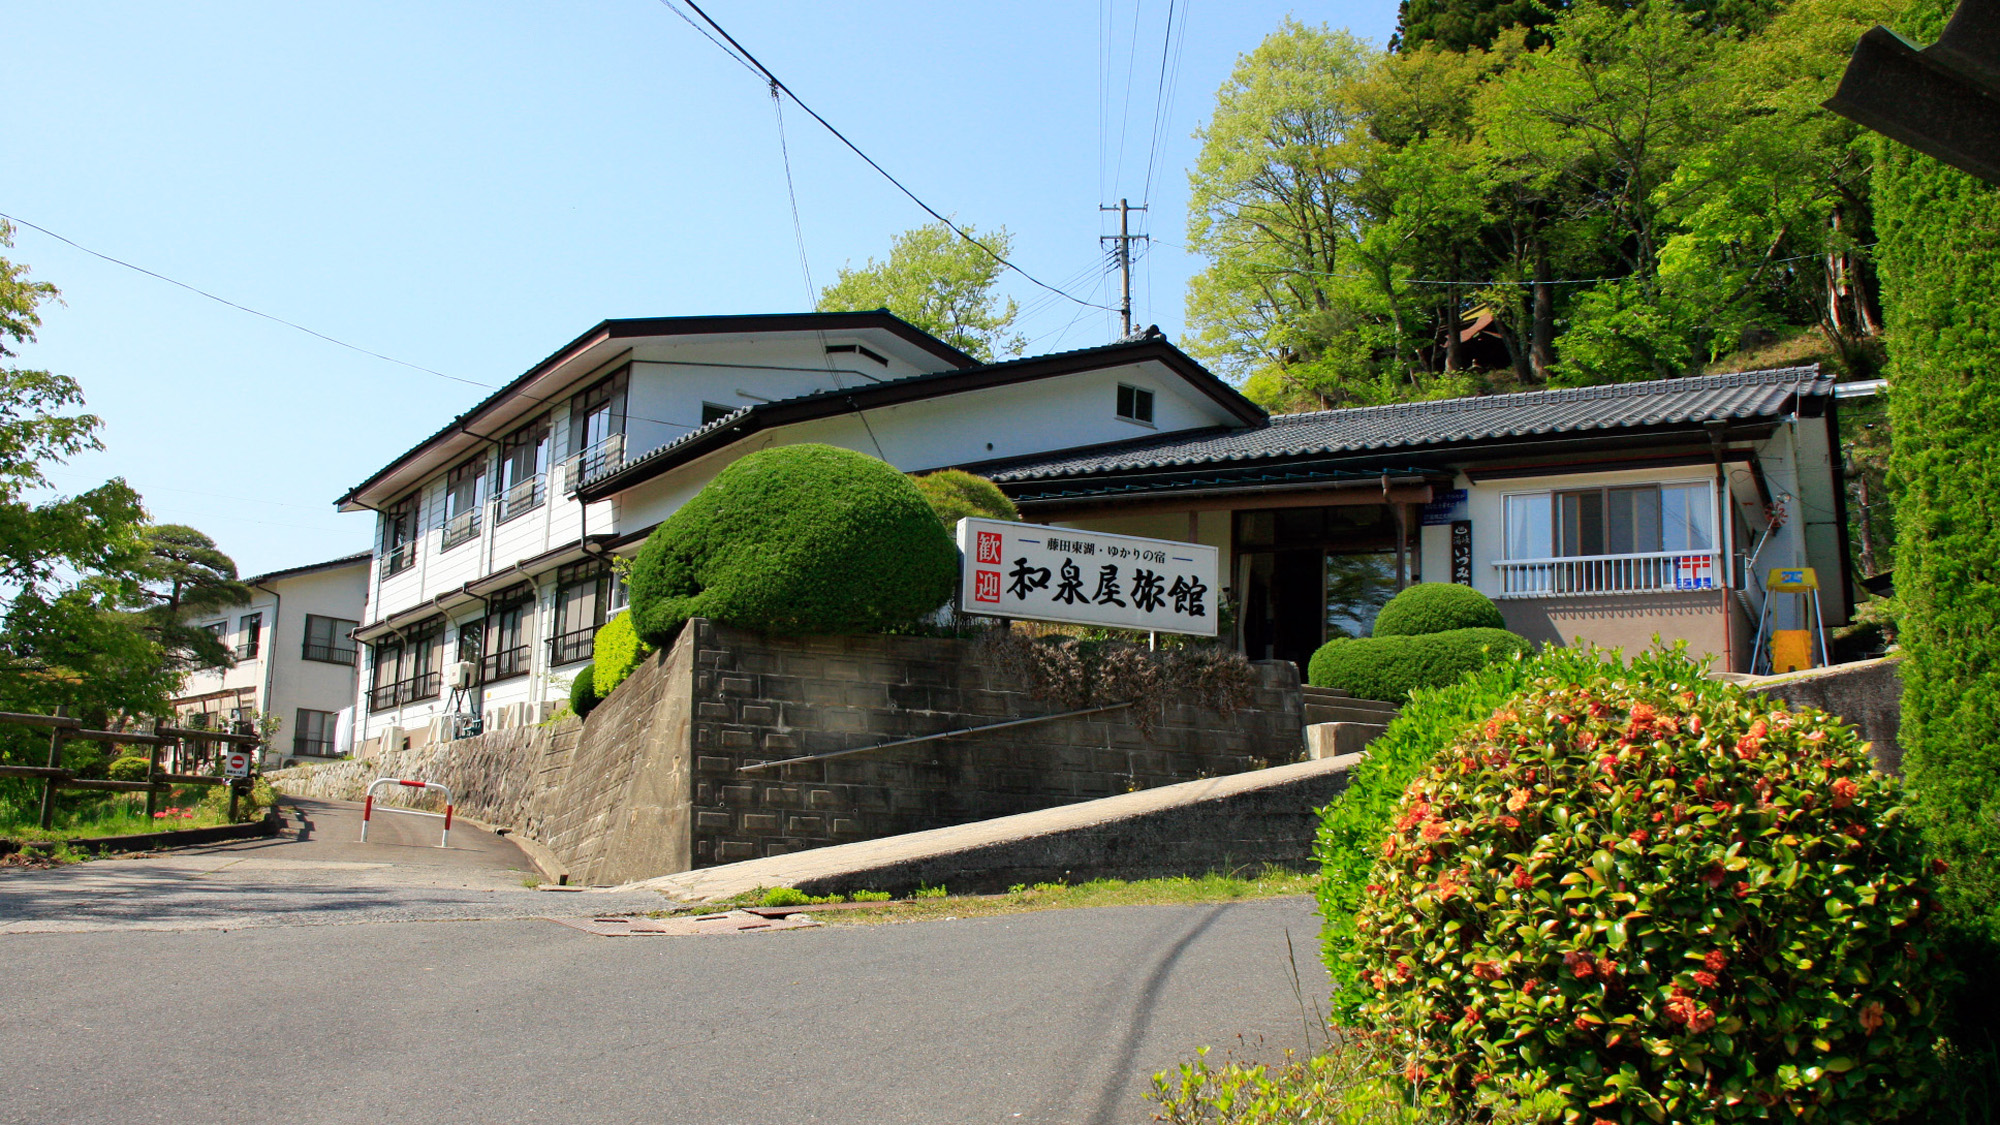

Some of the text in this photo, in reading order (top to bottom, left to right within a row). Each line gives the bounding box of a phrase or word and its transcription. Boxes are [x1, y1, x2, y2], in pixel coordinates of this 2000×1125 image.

[976, 532, 1002, 602] 歓迎
[1047, 537, 1166, 564] 藤田東湖・ゆかりの宿
[1006, 557, 1208, 617] 和泉屋旅館
